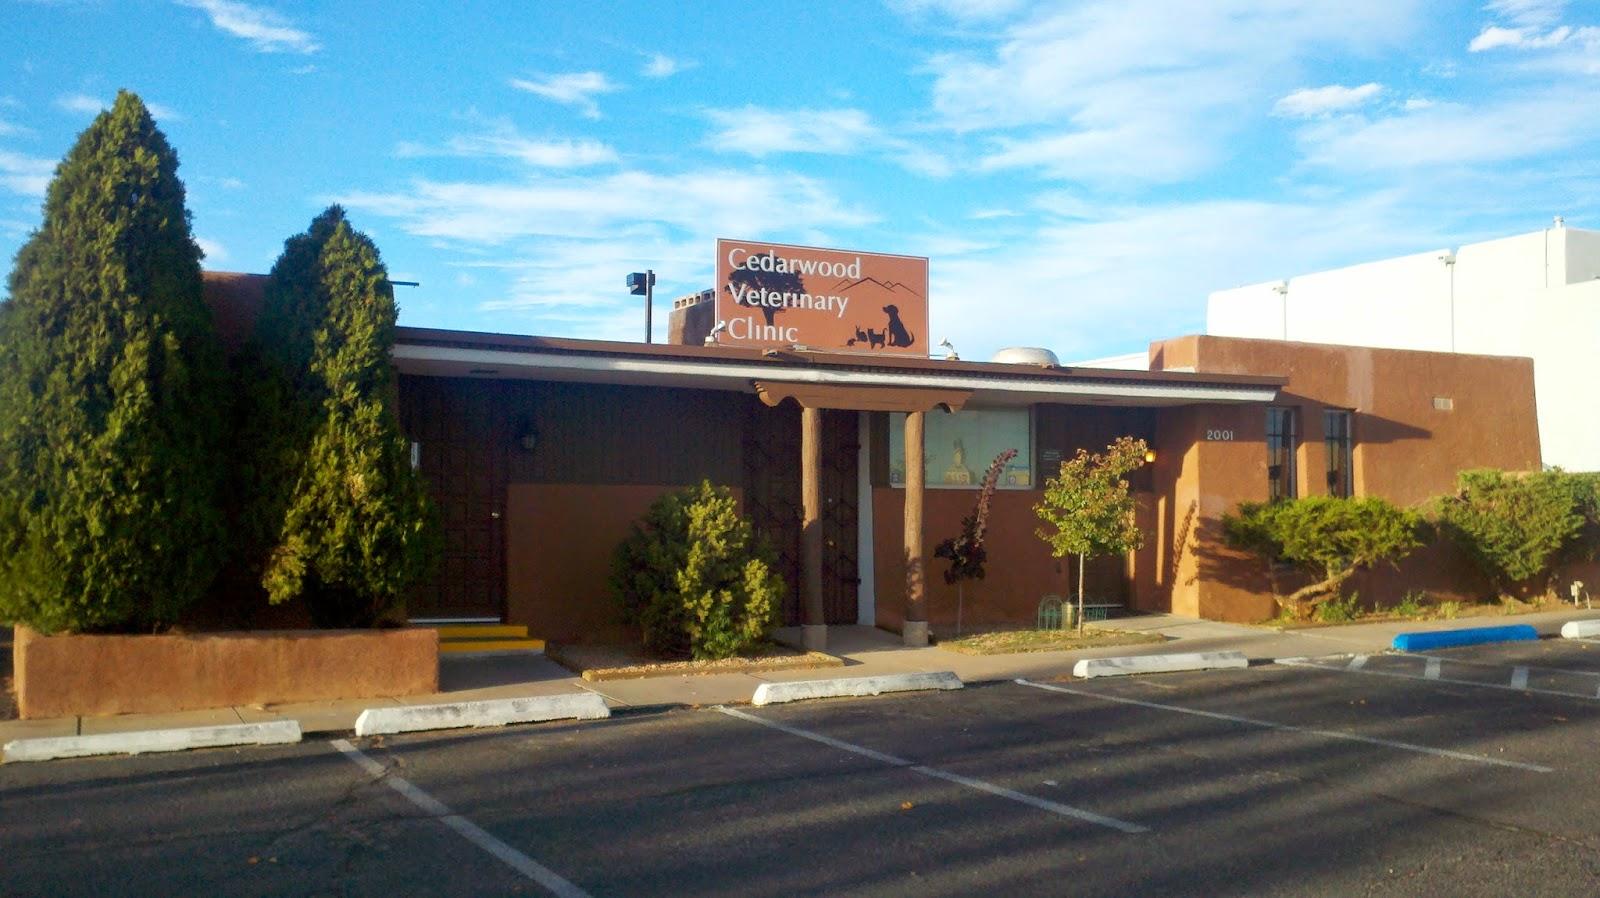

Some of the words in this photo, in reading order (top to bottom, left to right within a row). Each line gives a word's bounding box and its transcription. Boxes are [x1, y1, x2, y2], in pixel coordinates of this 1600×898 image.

[728, 248, 861, 279] Cedarwood
[728, 283, 849, 318] Veterinary
[728, 316, 799, 342] Clinic
[1206, 429, 1234, 441] 2001
